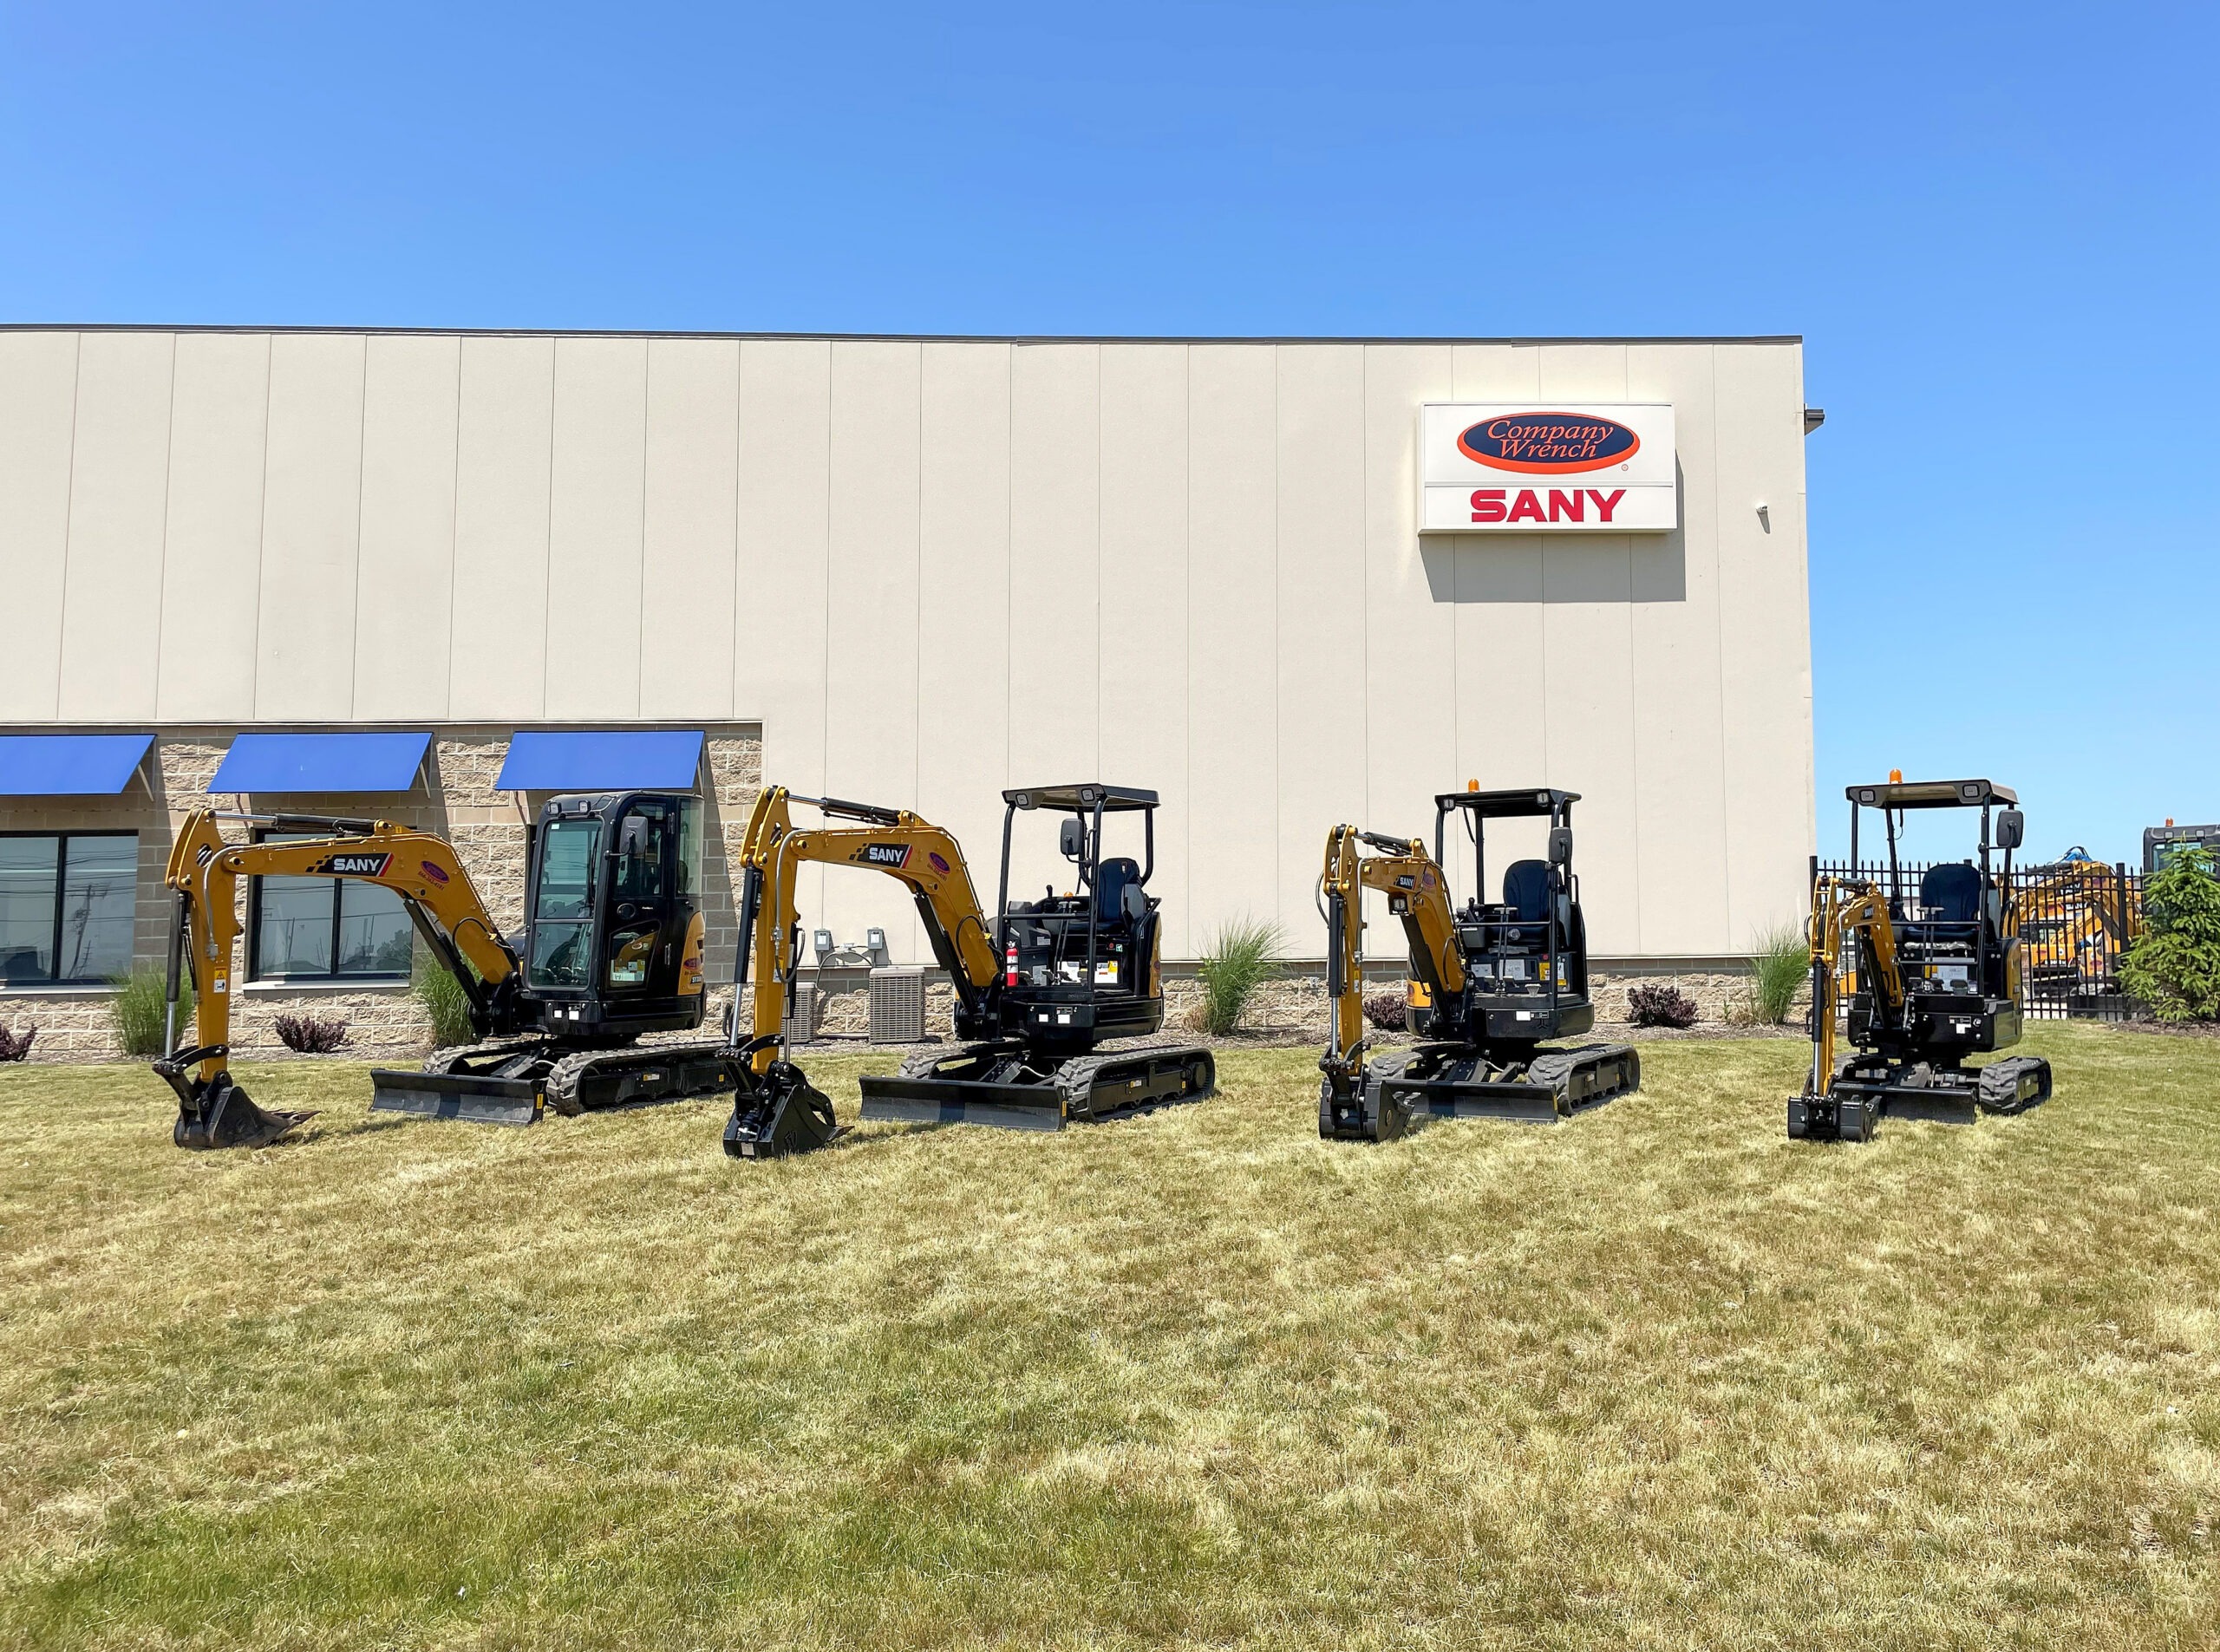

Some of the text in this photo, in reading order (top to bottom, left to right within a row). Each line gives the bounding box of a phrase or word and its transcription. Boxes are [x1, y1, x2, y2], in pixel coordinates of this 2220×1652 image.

[1488, 420, 1614, 445] Company
[1499, 439, 1596, 458] Wrench
[1470, 489, 1627, 523] SANY
[869, 847, 904, 863] SANY
[333, 858, 381, 872] SANY
[1400, 877, 1414, 887] SANY
